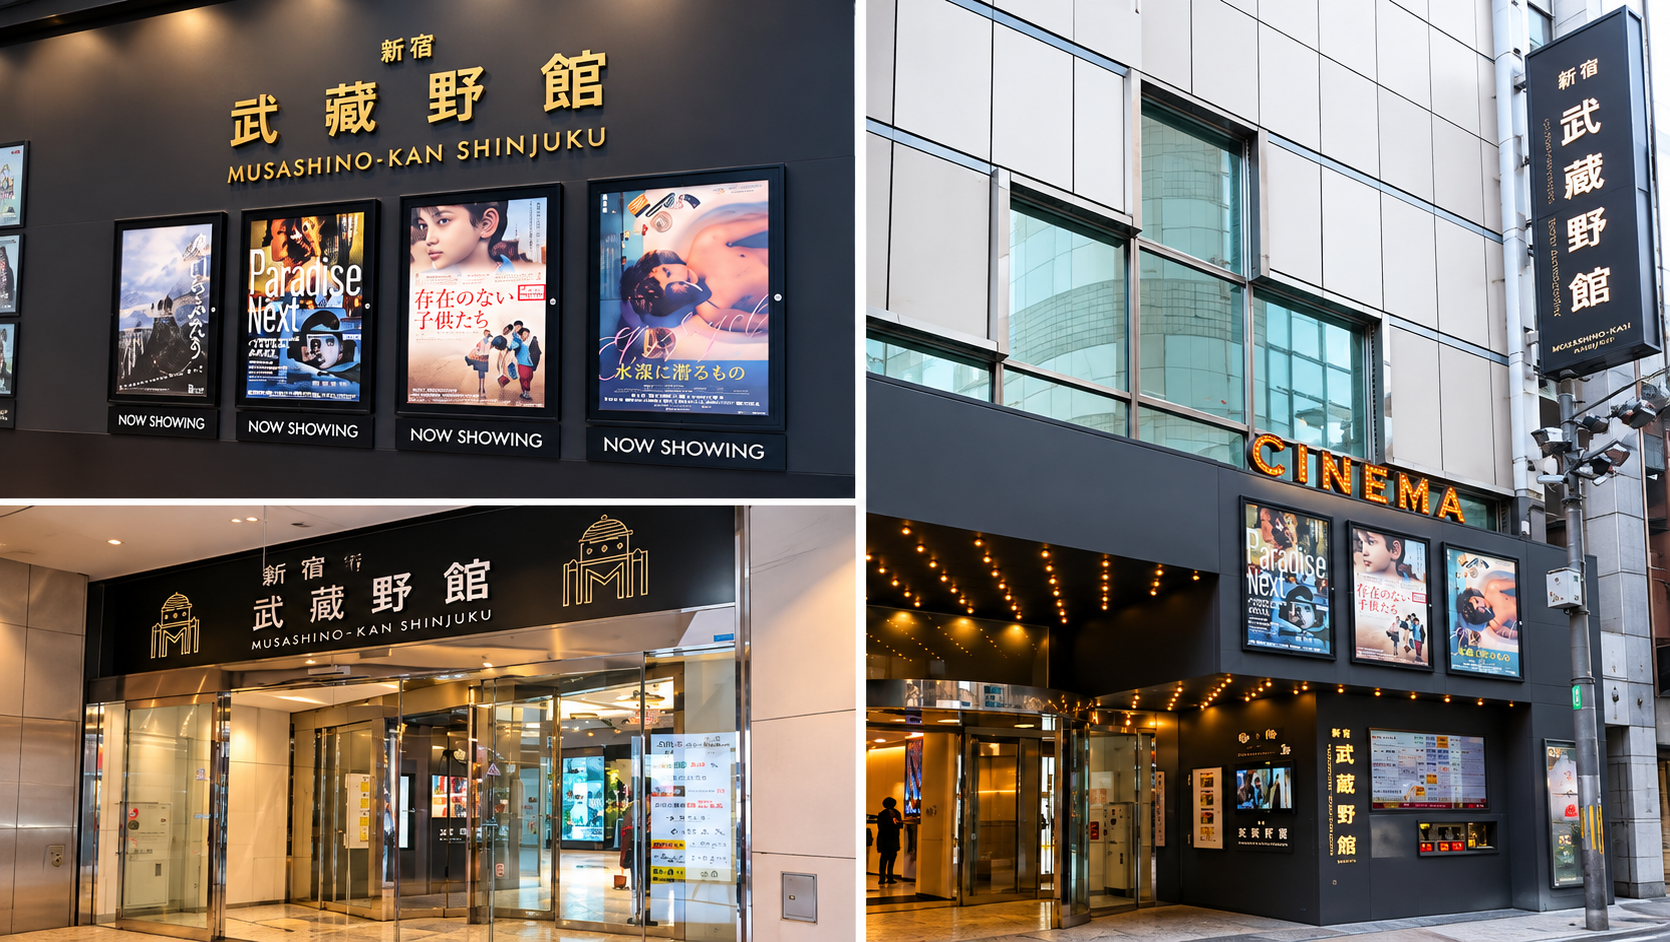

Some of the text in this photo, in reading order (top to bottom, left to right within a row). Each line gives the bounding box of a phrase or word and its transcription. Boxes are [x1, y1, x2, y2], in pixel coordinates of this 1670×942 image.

[380, 33, 436, 64] 新宿
[1557, 57, 1599, 91] 新宿
[227, 126, 607, 184] MUSASHINO-KAN SHINJUKU
[248, 248, 363, 298] Paradise
[414, 287, 515, 311] 存在のない
[247, 296, 301, 335] Next
[414, 309, 489, 331] 子供たち
[118, 414, 206, 431] NOW SHOWING
[248, 420, 359, 439] NOW SHOWING
[410, 427, 543, 448] NOW SHOWING
[603, 436, 766, 461] NOW SHOWING
[1248, 432, 1466, 524] CINEMA
[1246, 527, 1327, 579] Paradise
[1247, 567, 1287, 599] Next
[251, 609, 493, 651] MUSASHINO-KAN SHINJUKU
